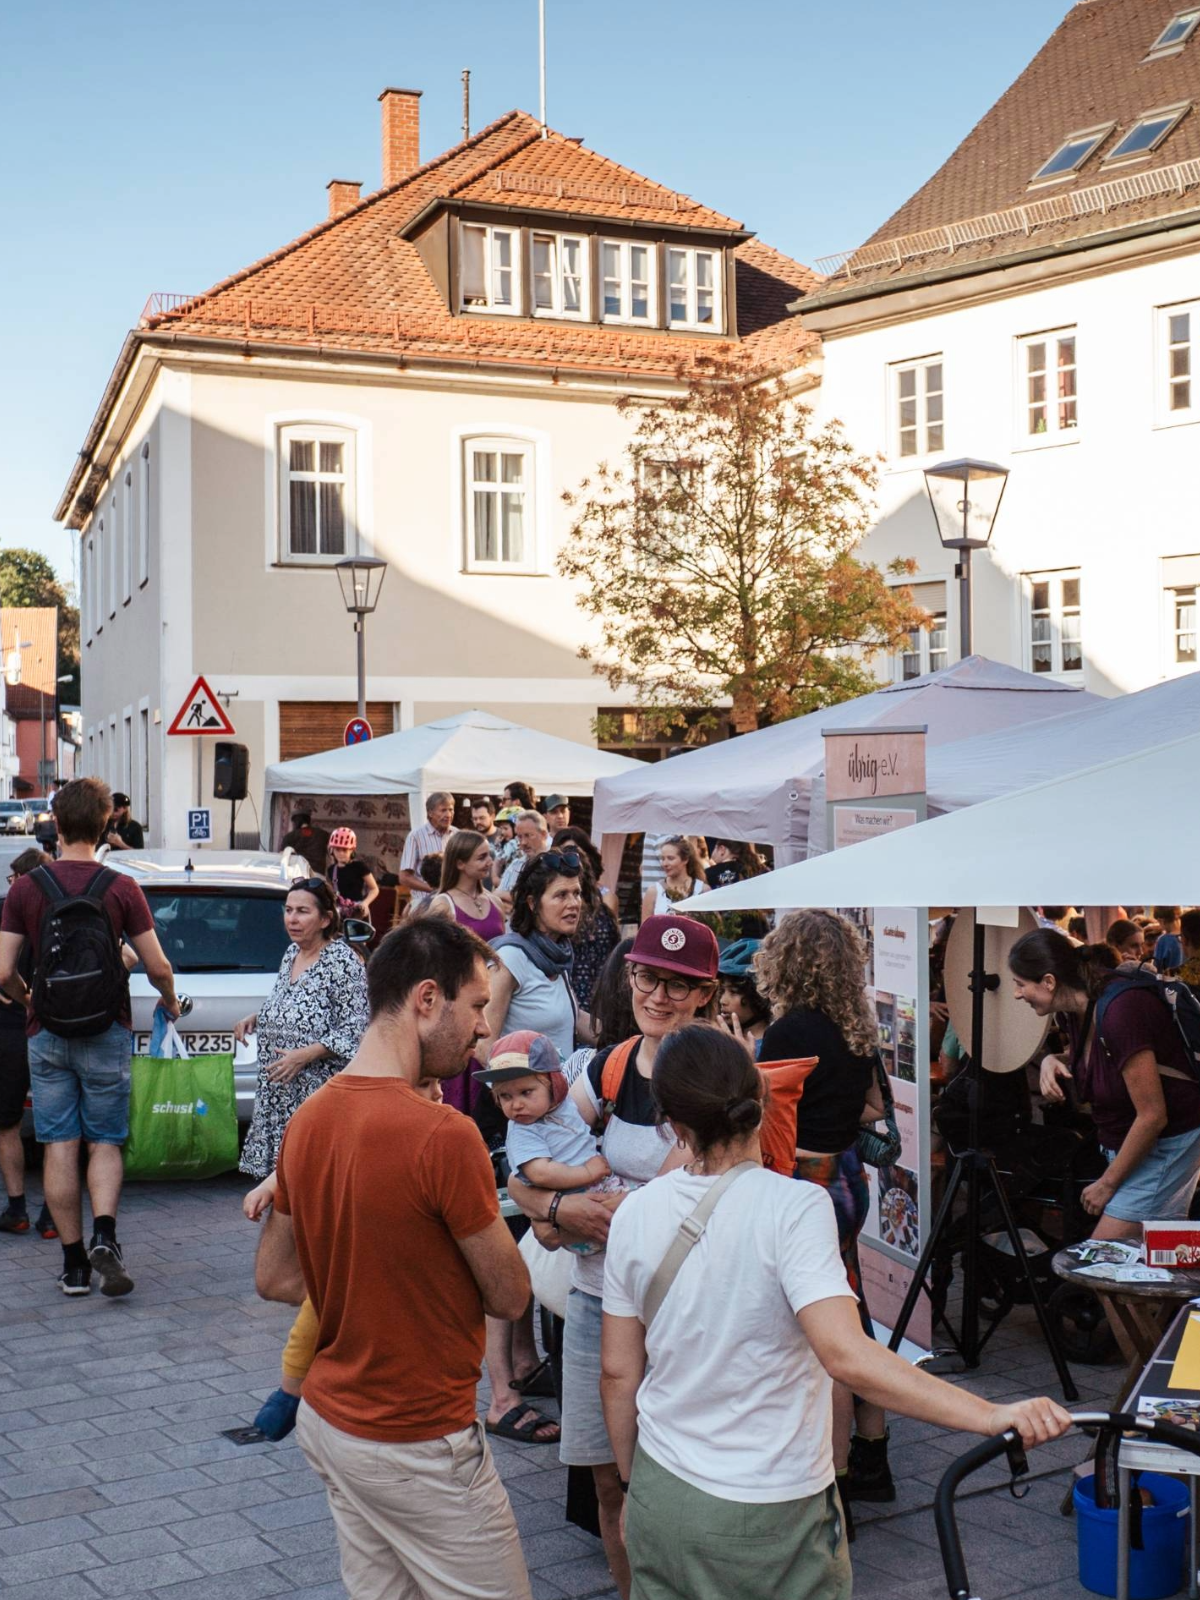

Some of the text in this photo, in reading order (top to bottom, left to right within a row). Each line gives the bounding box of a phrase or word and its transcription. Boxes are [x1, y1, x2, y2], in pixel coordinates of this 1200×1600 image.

[848, 743, 899, 795] übrig e.V.
[192, 813, 201, 827] P
[152, 1101, 194, 1114] schust
